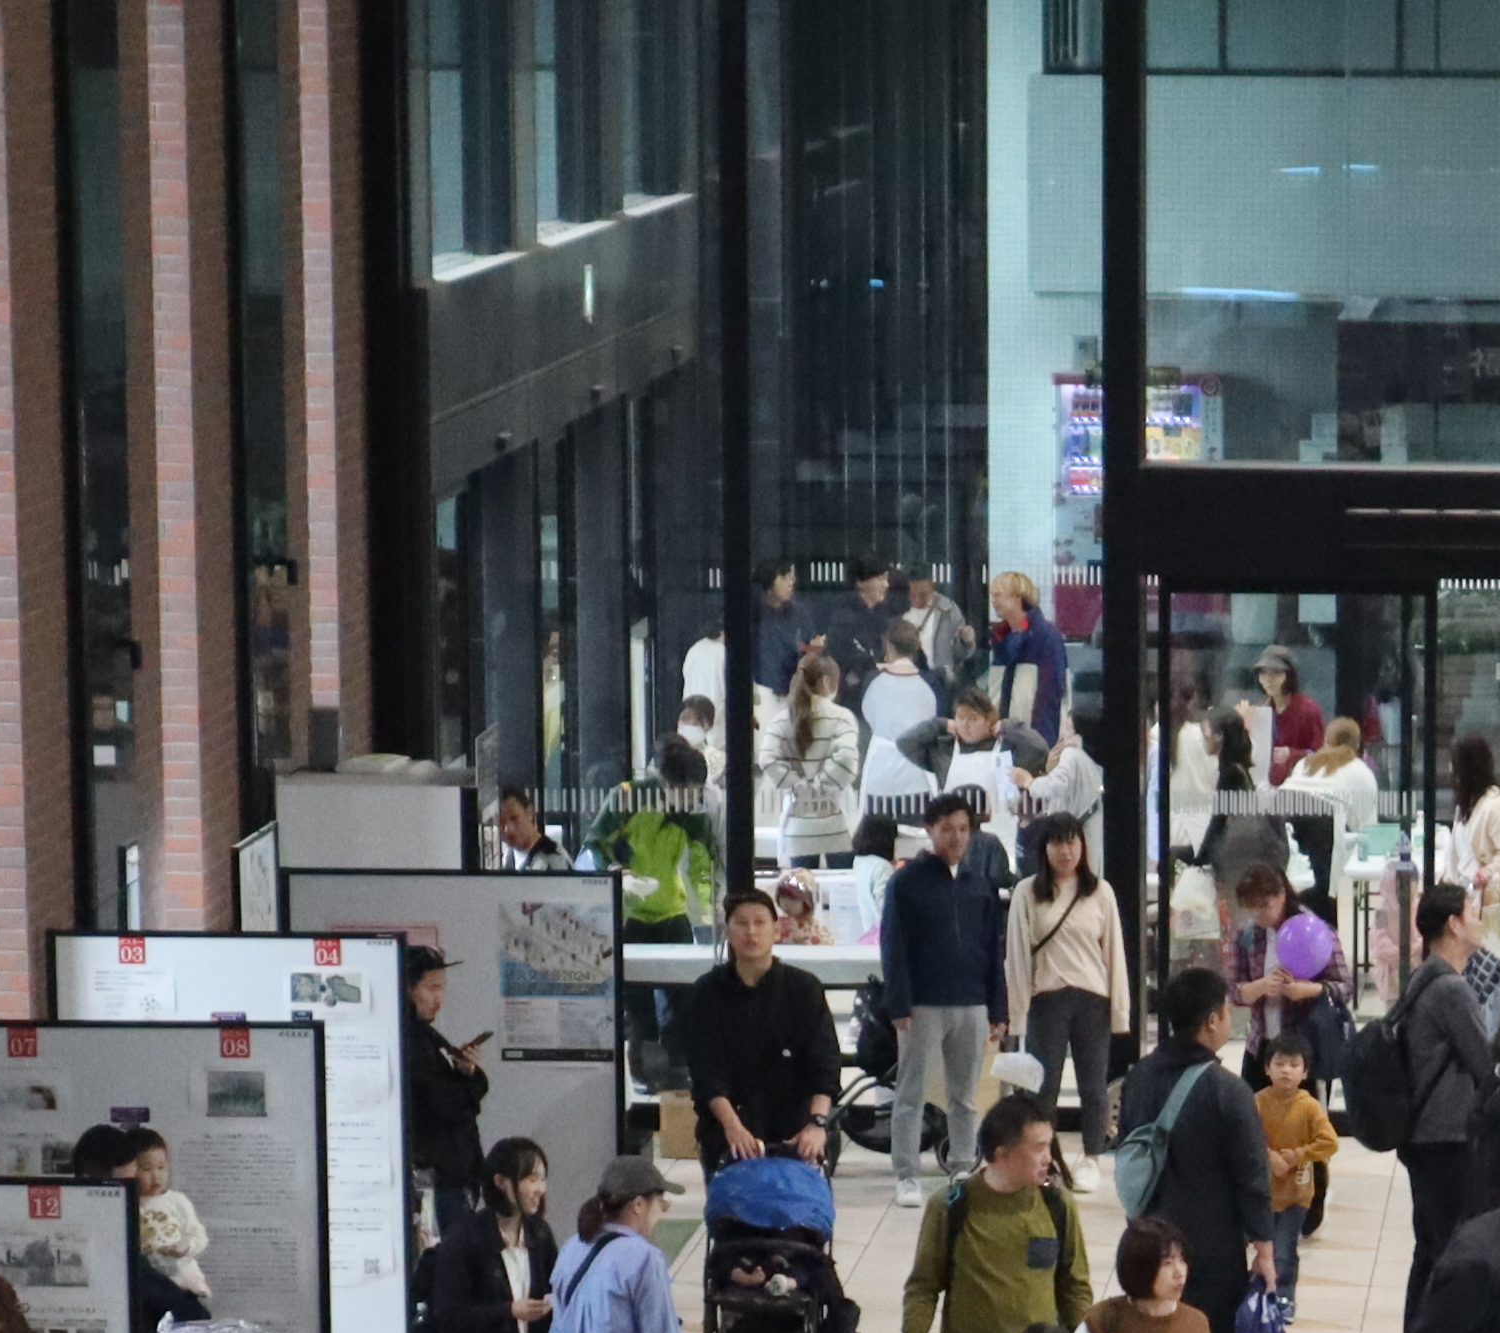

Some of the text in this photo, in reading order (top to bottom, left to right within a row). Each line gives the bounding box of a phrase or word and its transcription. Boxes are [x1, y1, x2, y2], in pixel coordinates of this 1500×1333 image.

[120, 949, 143, 963] 03
[315, 950, 339, 964] 04
[562, 971, 590, 981] 2024
[10, 1041, 37, 1056] 07
[222, 1041, 250, 1056] 08
[32, 1198, 60, 1217] 12
